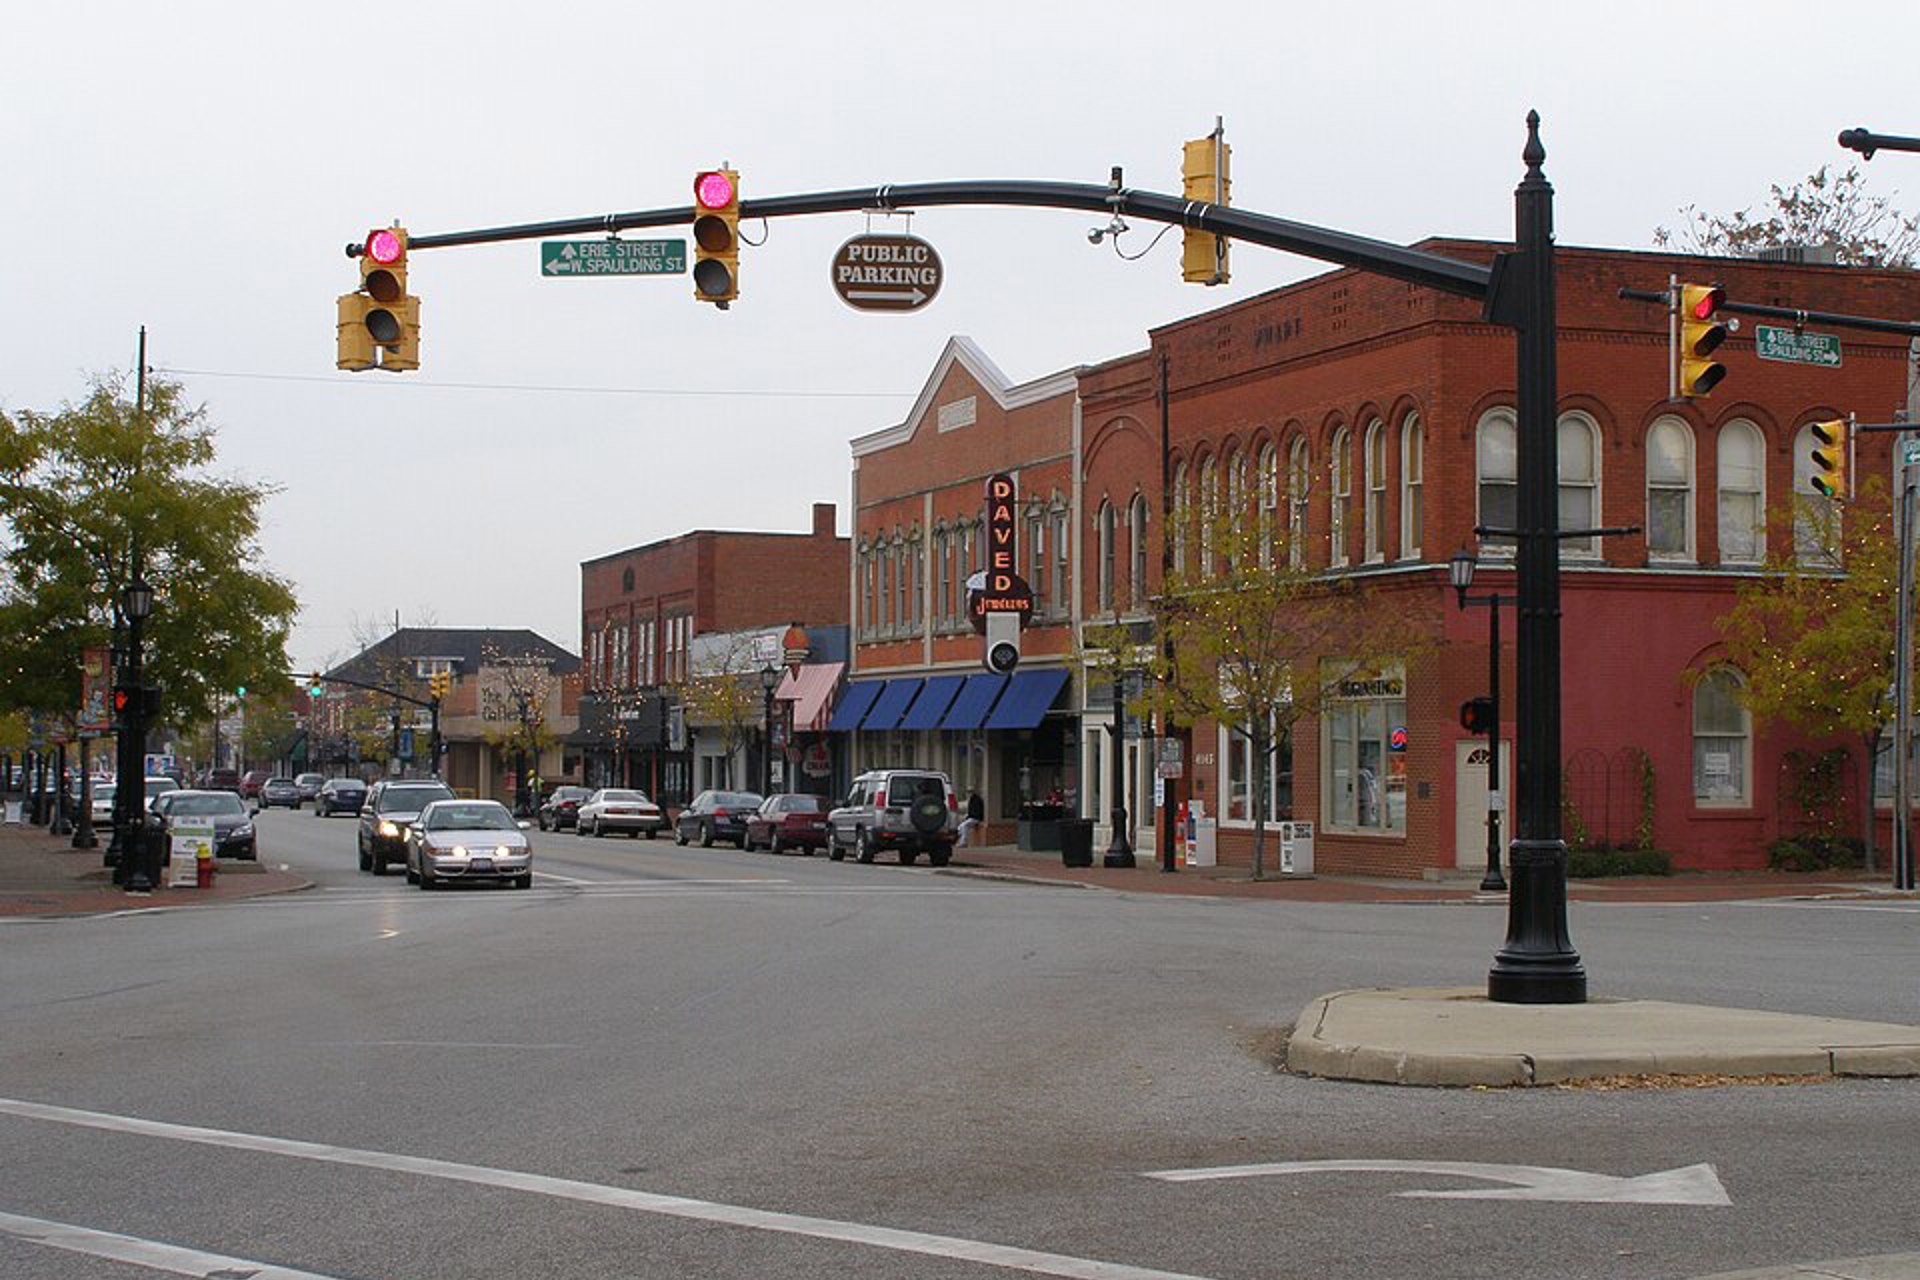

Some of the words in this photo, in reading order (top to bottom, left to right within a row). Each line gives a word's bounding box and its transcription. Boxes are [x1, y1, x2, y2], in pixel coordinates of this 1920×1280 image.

[579, 243, 611, 258] ERIE
[615, 242, 668, 257] STREET
[847, 245, 928, 263] PUBLIC
[570, 259, 585, 273] W.
[587, 258, 662, 273] SPAULDING
[665, 257, 684, 271] ST.
[838, 265, 937, 285] PARKING
